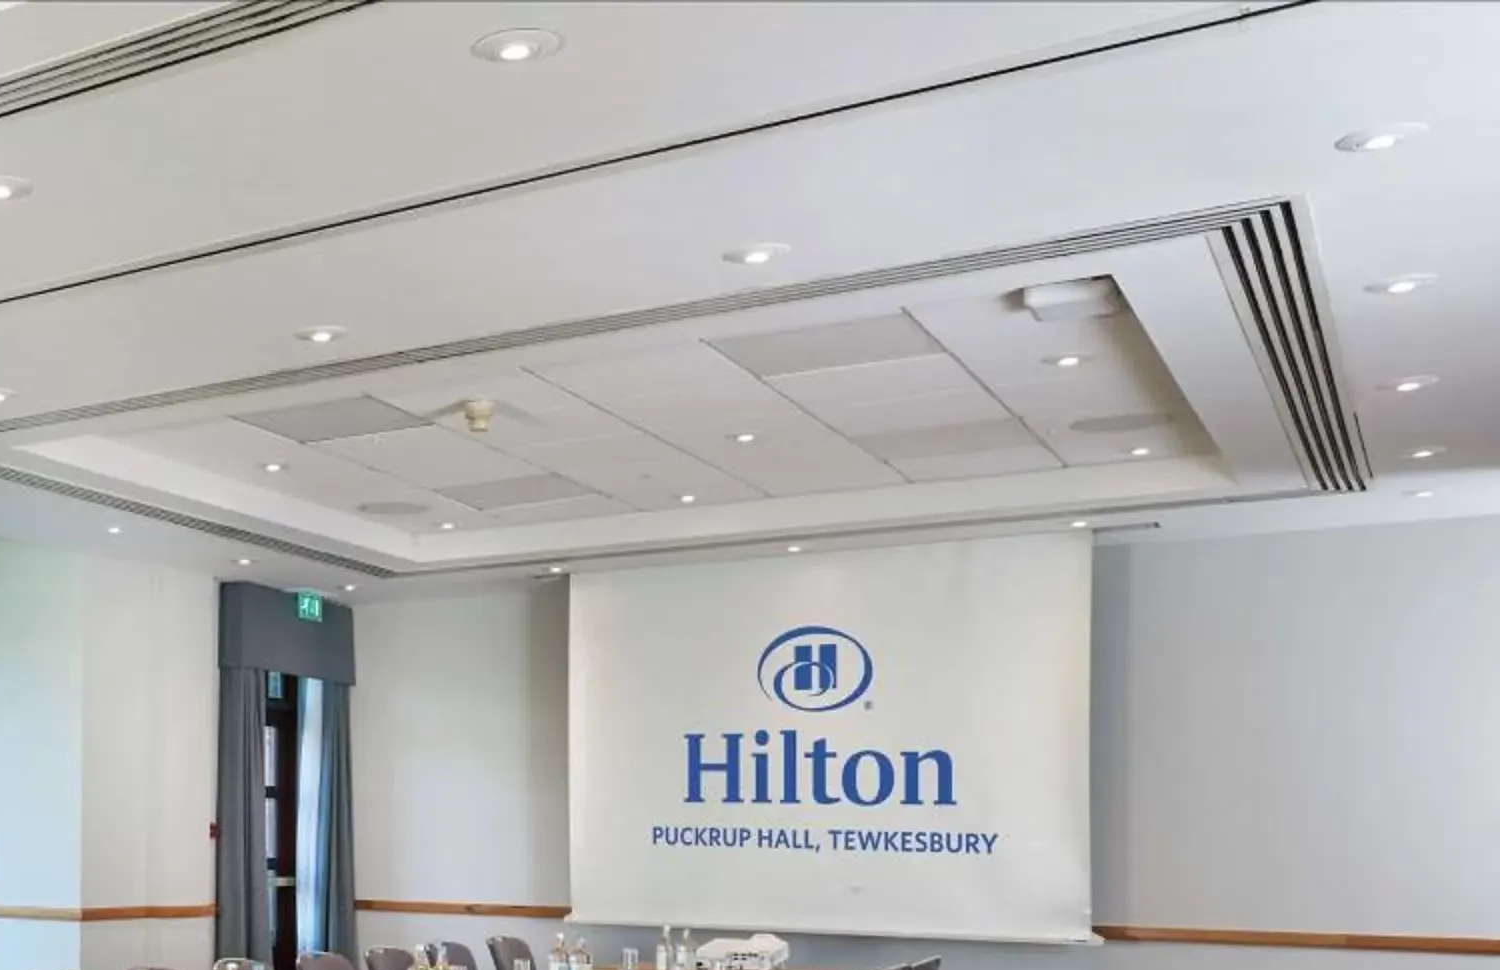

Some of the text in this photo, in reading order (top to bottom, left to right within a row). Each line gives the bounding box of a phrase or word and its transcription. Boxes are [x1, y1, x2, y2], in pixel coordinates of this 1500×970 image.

[683, 728, 958, 807] Hilton
[652, 826, 999, 854] PUCKRUP HALL, TEWKESBURY
